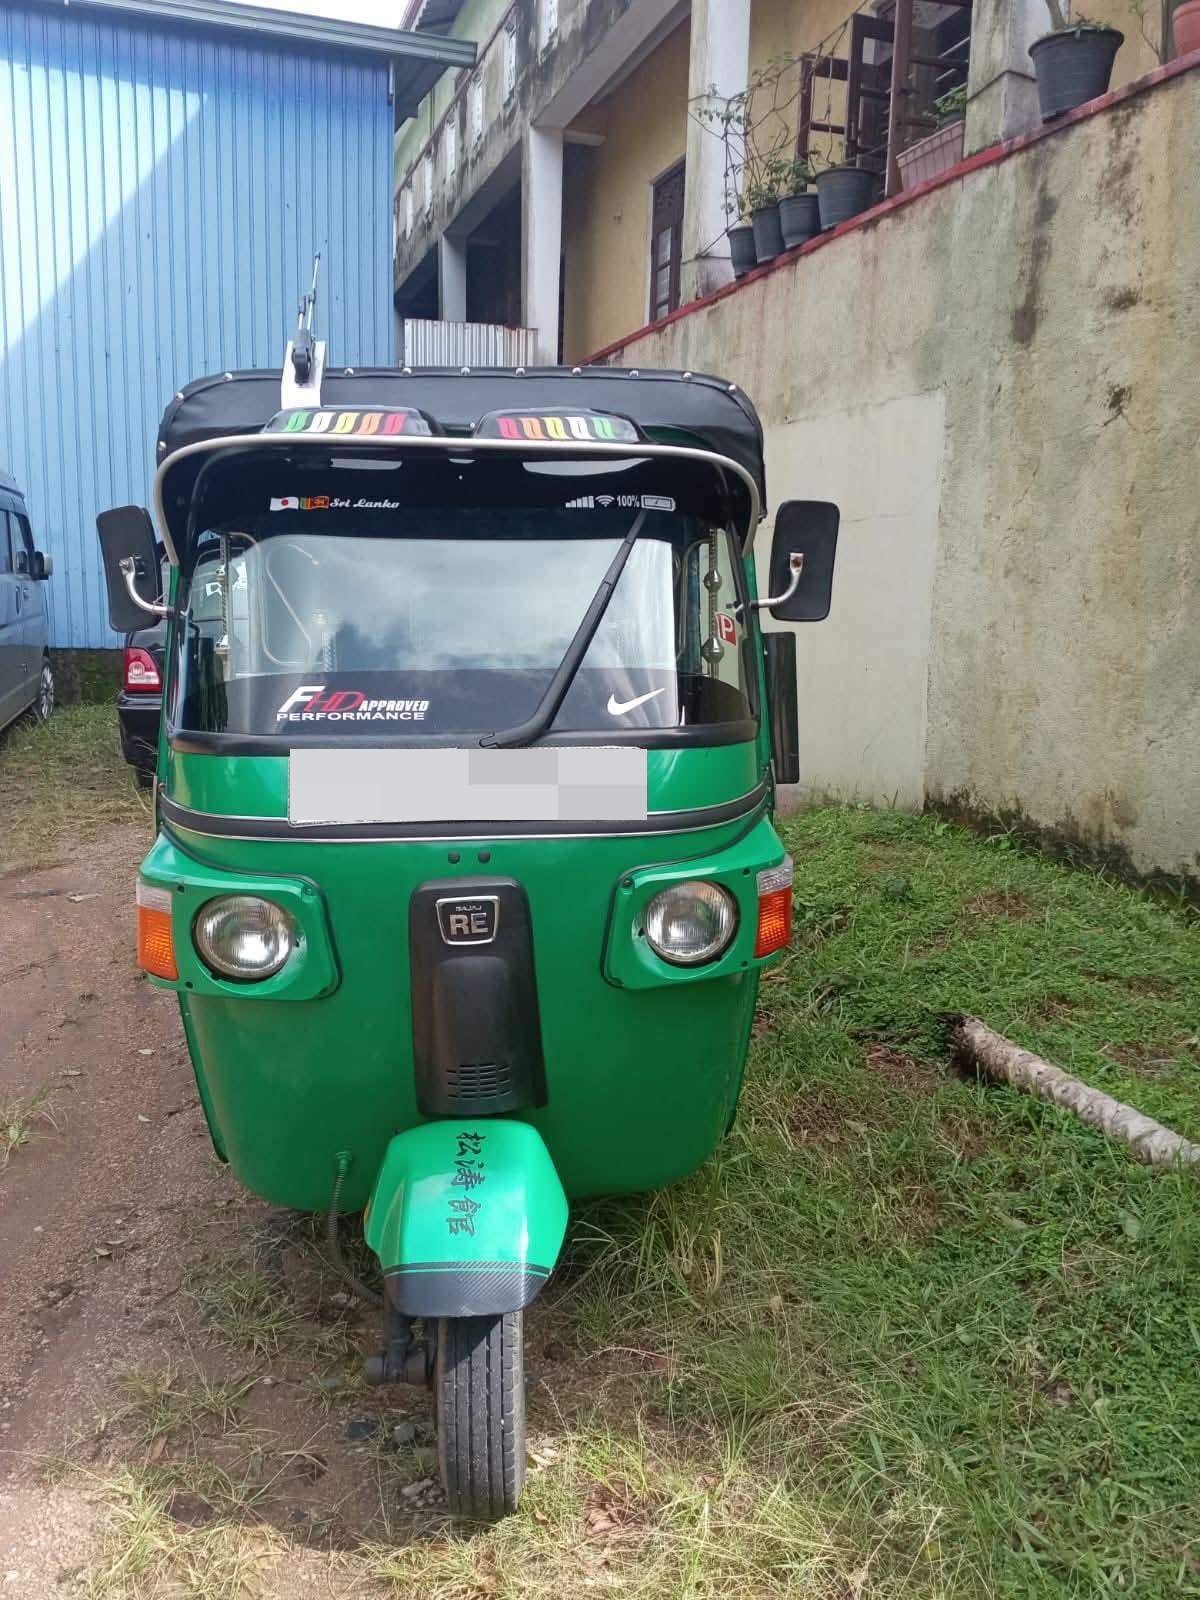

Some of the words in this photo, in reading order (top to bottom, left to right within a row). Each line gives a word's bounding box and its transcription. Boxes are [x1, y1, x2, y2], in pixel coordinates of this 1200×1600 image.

[329, 498, 351, 508] Sri
[353, 499, 399, 509] Lanka
[616, 495, 640, 508] 100%
[358, 700, 430, 712] APPROVED
[276, 711, 425, 721] PERFORMANCE
[449, 912, 489, 936] RE
